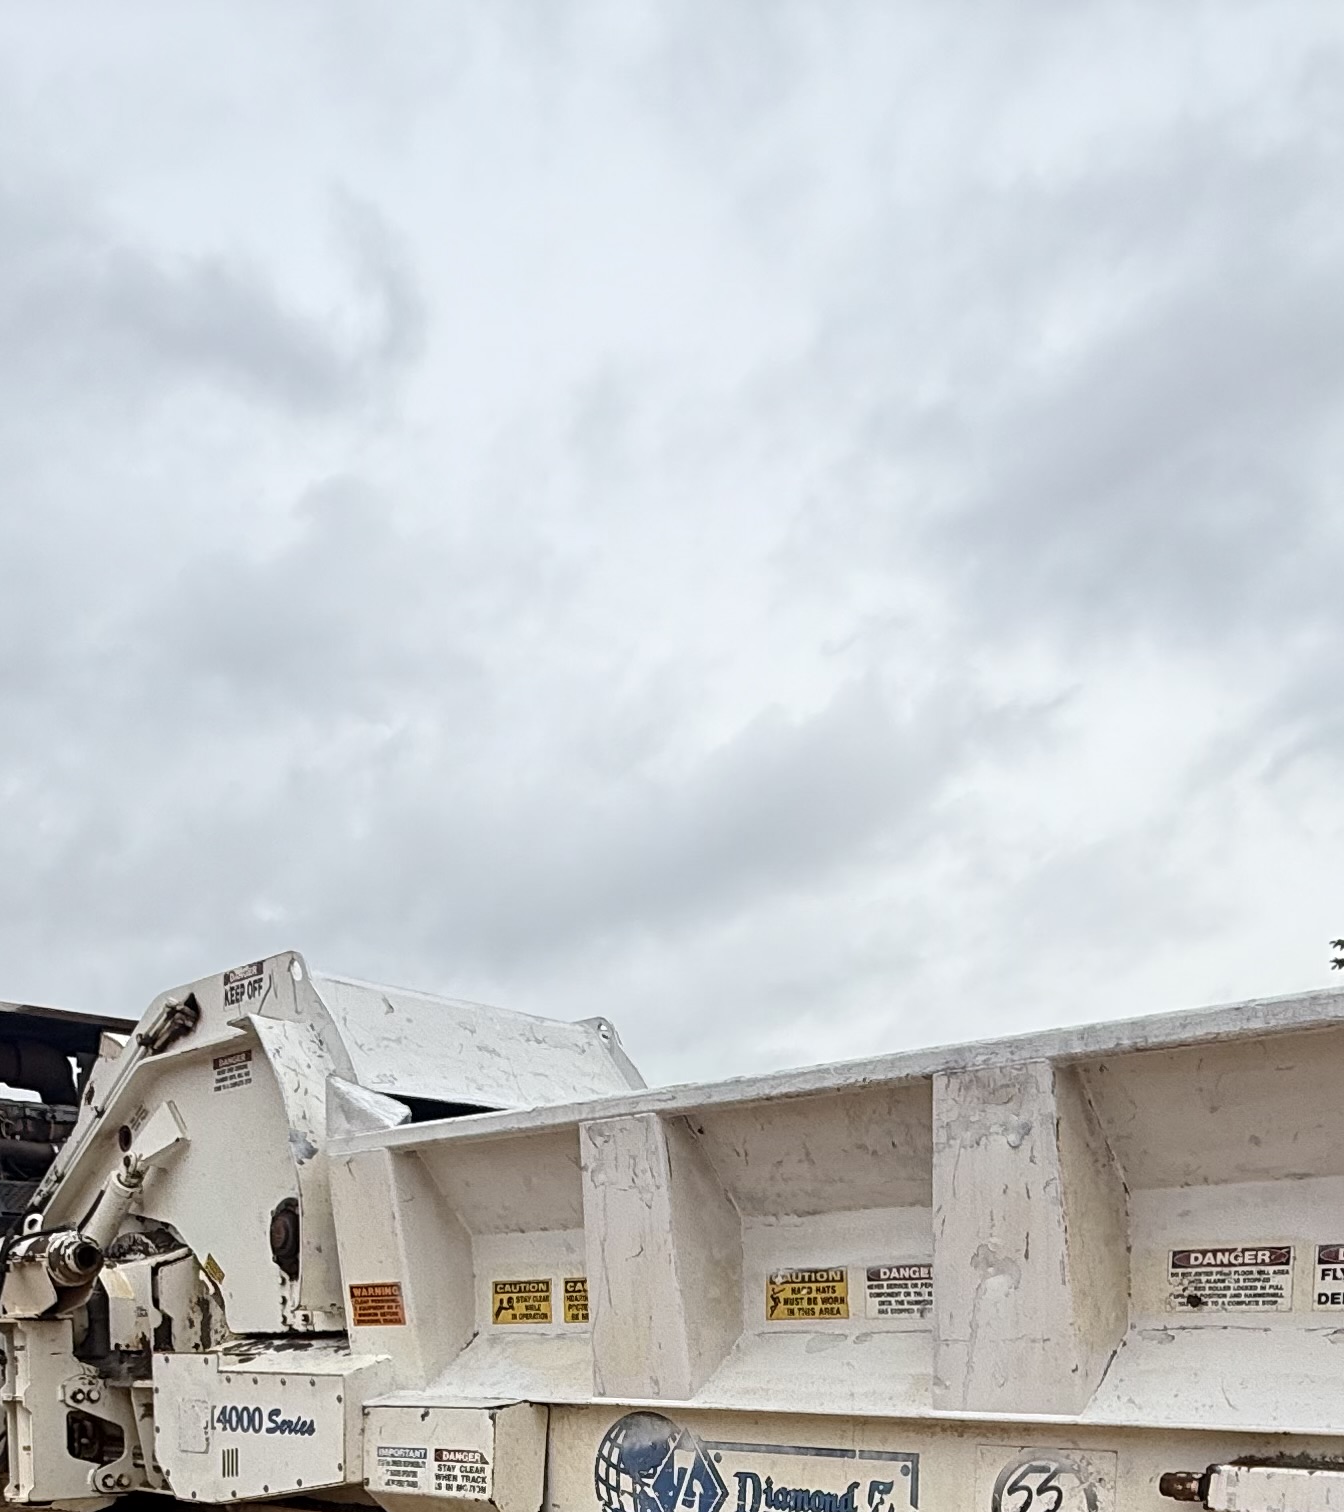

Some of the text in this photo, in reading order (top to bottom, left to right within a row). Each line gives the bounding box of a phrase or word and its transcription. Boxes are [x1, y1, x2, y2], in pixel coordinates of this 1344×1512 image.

[225, 978, 263, 1006] KEEP OFF
[1190, 1251, 1271, 1265] DANGER
[880, 1266, 933, 1279] DANGE
[352, 1285, 400, 1297] WARNING
[496, 1283, 547, 1293] CAUTION
[815, 1285, 837, 1295] HATS
[515, 1295, 549, 1303] STAY CLEAR
[783, 1296, 845, 1306] MUST BE WORN
[787, 1307, 842, 1316] IN THIS AREA
[266, 1408, 316, 1436] Series
[378, 1447, 426, 1459] IMPORTANT
[442, 1450, 482, 1464] DANGER
[437, 1464, 486, 1474] STAY CLEAR
[435, 1473, 488, 1484] WHEN TRACK
